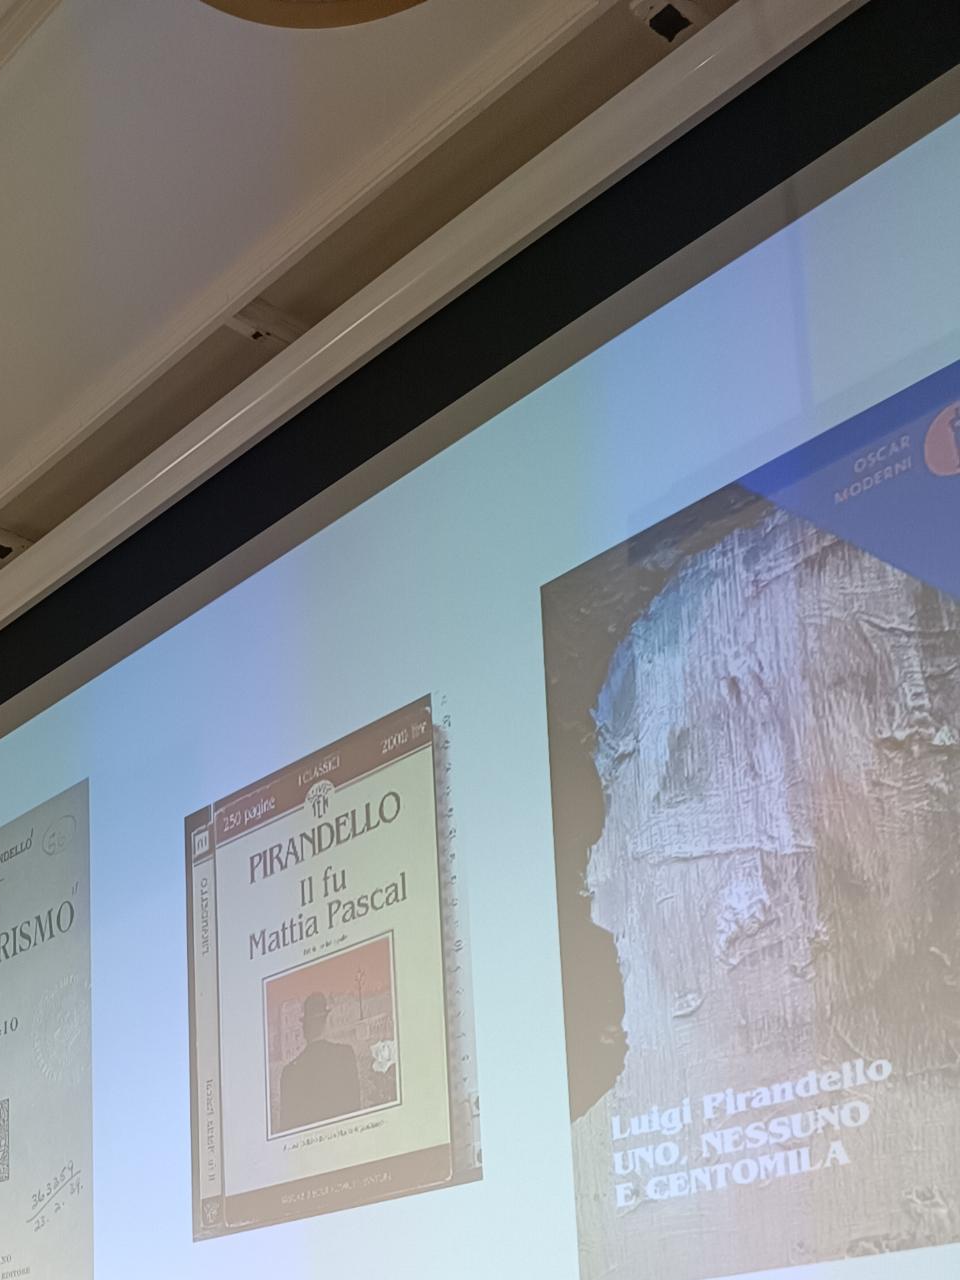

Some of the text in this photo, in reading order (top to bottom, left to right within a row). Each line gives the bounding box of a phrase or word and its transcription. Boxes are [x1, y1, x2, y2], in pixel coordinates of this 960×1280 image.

[833, 456, 912, 505] MODERNI
[853, 434, 911, 473] OSCAR
[224, 806, 242, 832] 250
[244, 797, 275, 826] pagine
[248, 791, 401, 885] PIRANDELLO
[249, 913, 318, 960] Mattia
[328, 872, 407, 929] Pascal
[300, 866, 347, 907] Il fu
[611, 1058, 893, 1141] Luigi Pirandello
[613, 1100, 870, 1176] UNO, NESSUNO
[616, 1140, 852, 1208] E CENTOMILA
